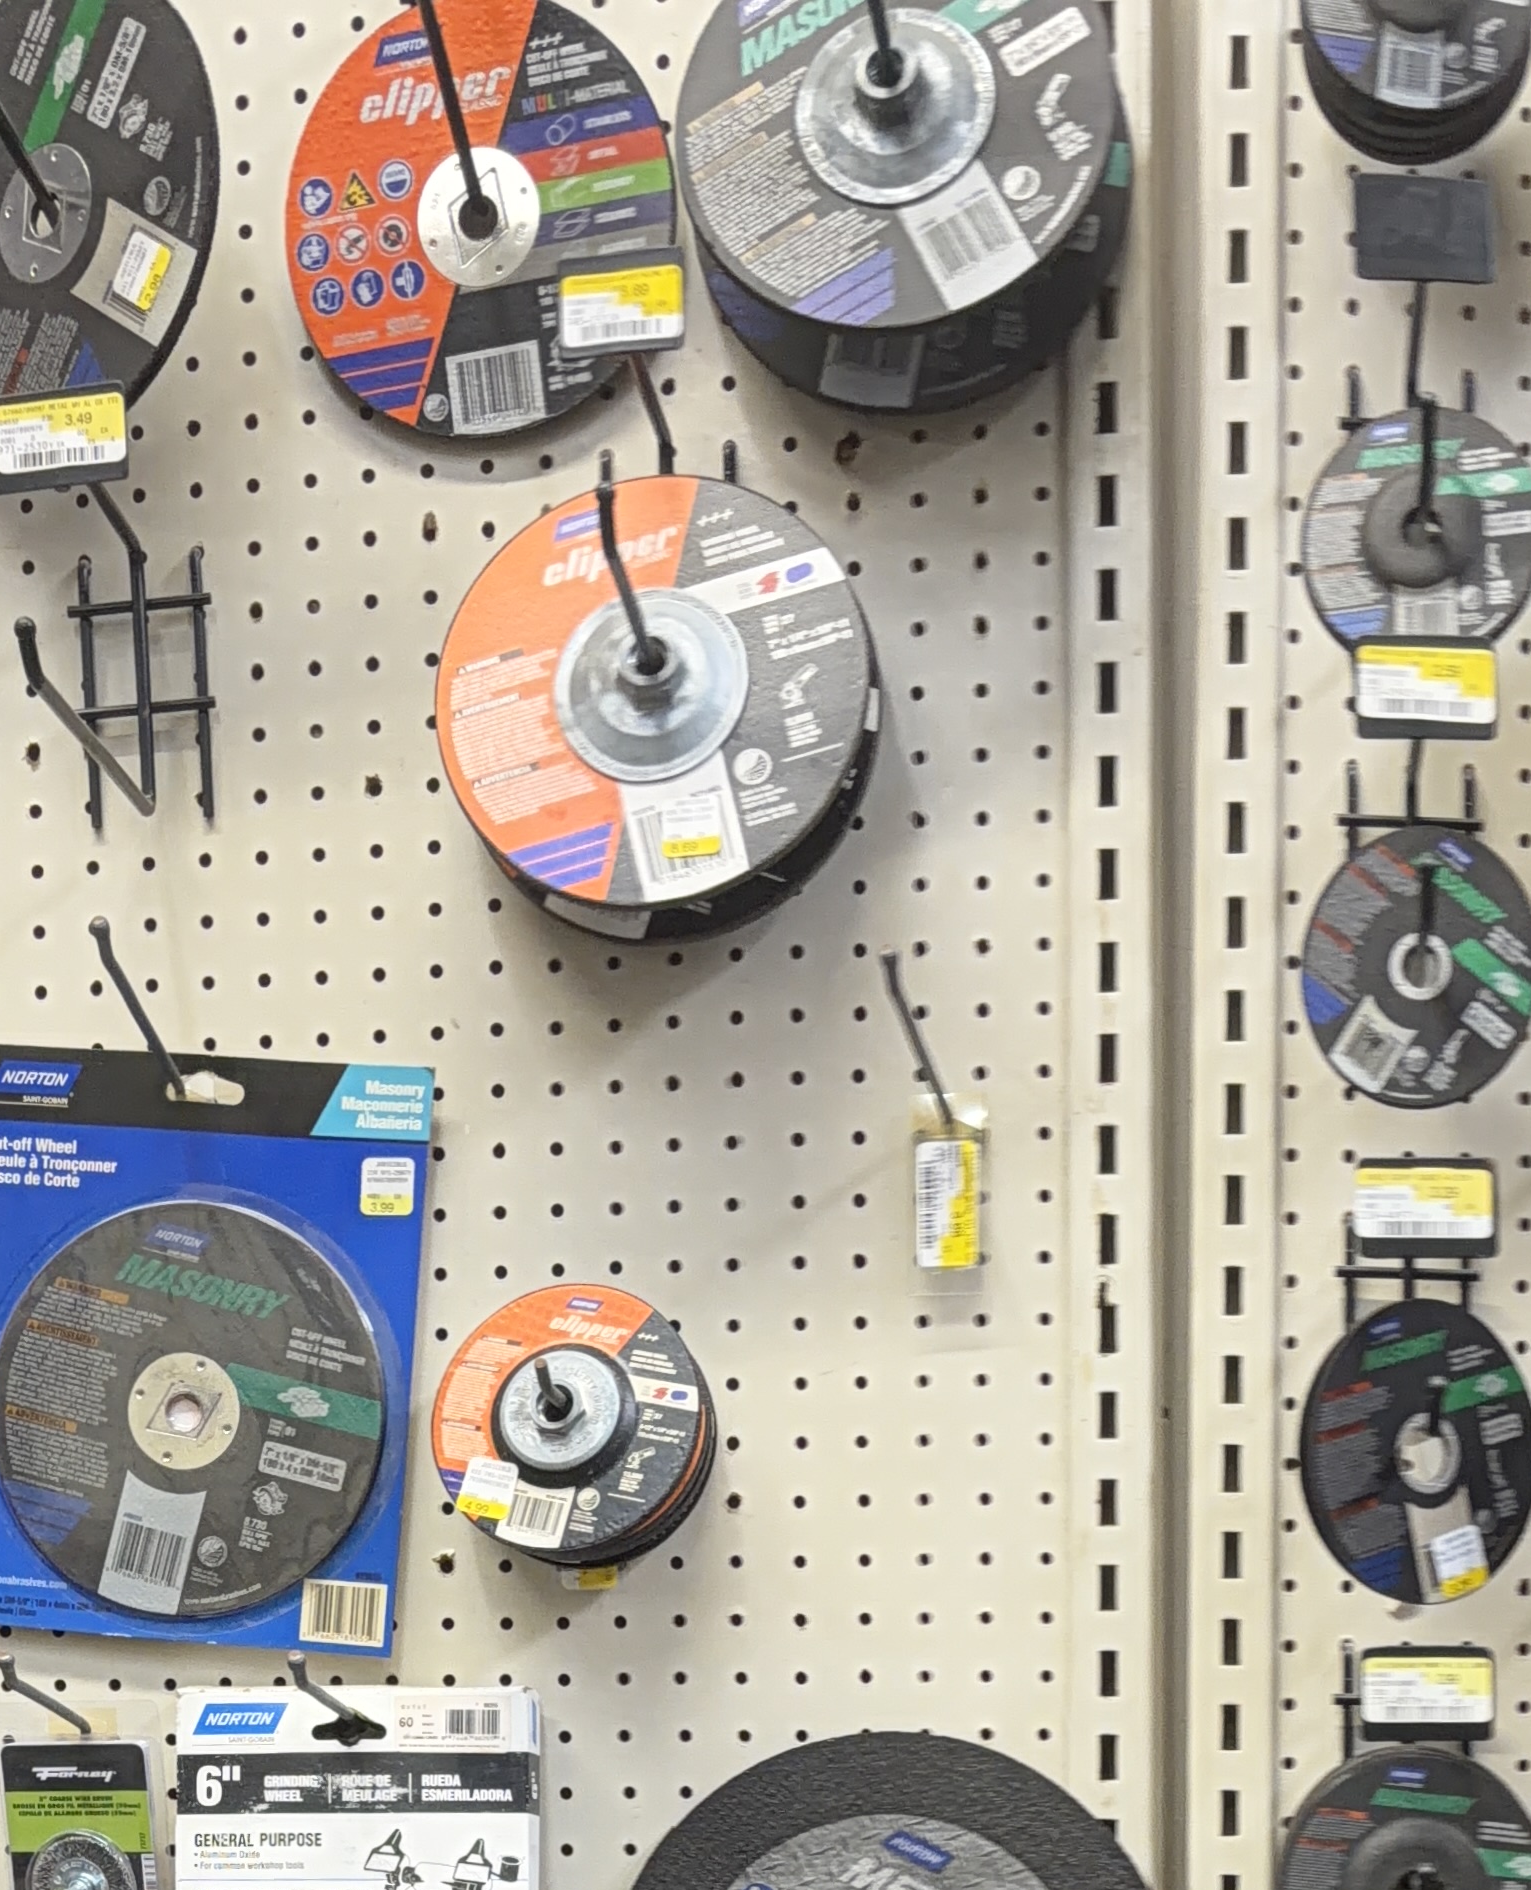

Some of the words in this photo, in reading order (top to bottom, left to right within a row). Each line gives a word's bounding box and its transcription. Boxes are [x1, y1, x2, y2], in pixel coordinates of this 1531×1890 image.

[64, 412, 92, 426] 3.49
[1, 1070, 69, 1086] NORTON
[366, 1080, 425, 1099] Masonry
[341, 1096, 424, 1116] Maçonnerie
[35, 1137, 78, 1154] Wheel
[24, 1170, 41, 1185] de
[43, 1171, 80, 1188] Corte
[370, 1202, 395, 1214] 3.99
[114, 1254, 291, 1319] MASONRY
[205, 1712, 274, 1726] NORTON
[399, 1717, 414, 1728] 60
[195, 1765, 242, 1807] 6"
[421, 1774, 461, 1787] RUEDA
[194, 1833, 254, 1848] GENERAL
[259, 1833, 322, 1847] PURPOSE
